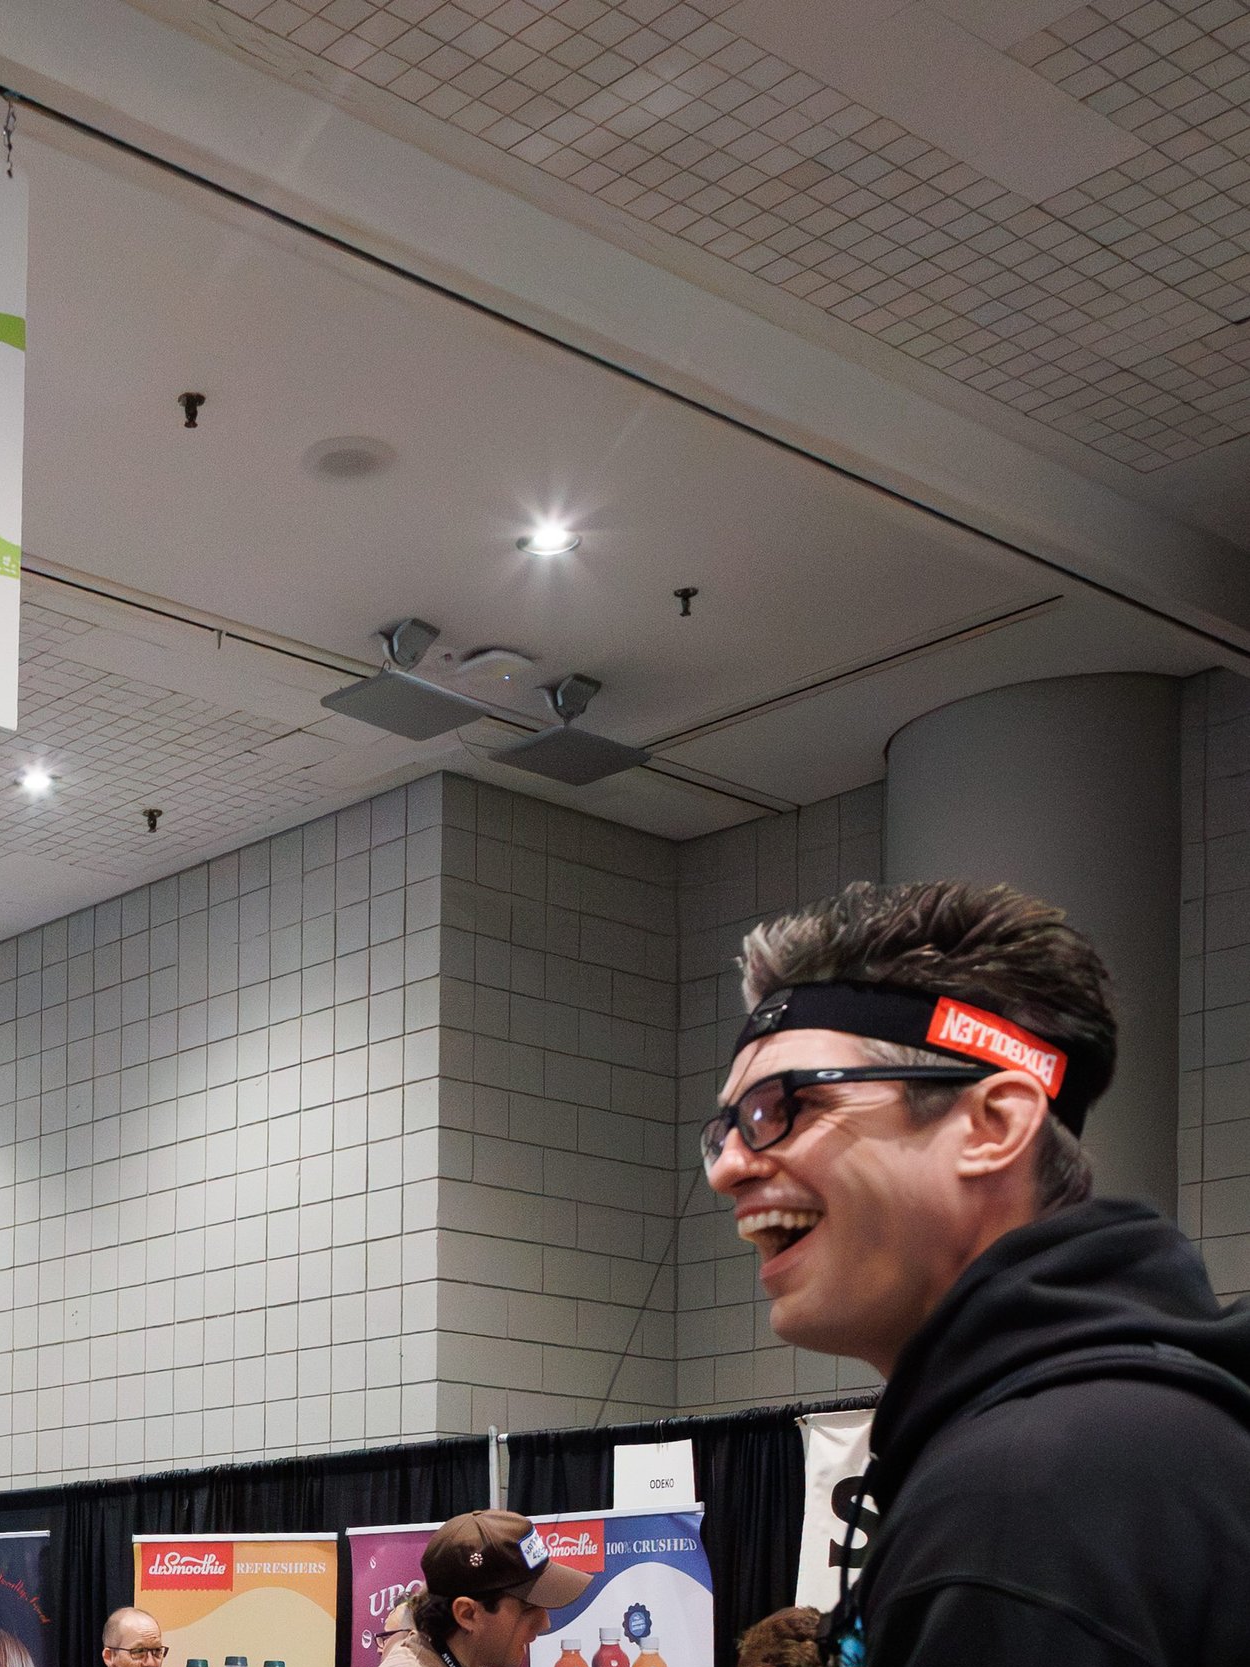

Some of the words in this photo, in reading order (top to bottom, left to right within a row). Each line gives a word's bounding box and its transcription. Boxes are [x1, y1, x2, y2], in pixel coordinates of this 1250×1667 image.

[649, 1478, 675, 1490] ODEKO
[540, 1533, 599, 1557] Smoothie
[633, 1538, 697, 1553] CRUSHED
[236, 1562, 327, 1575] REFRESHERS
